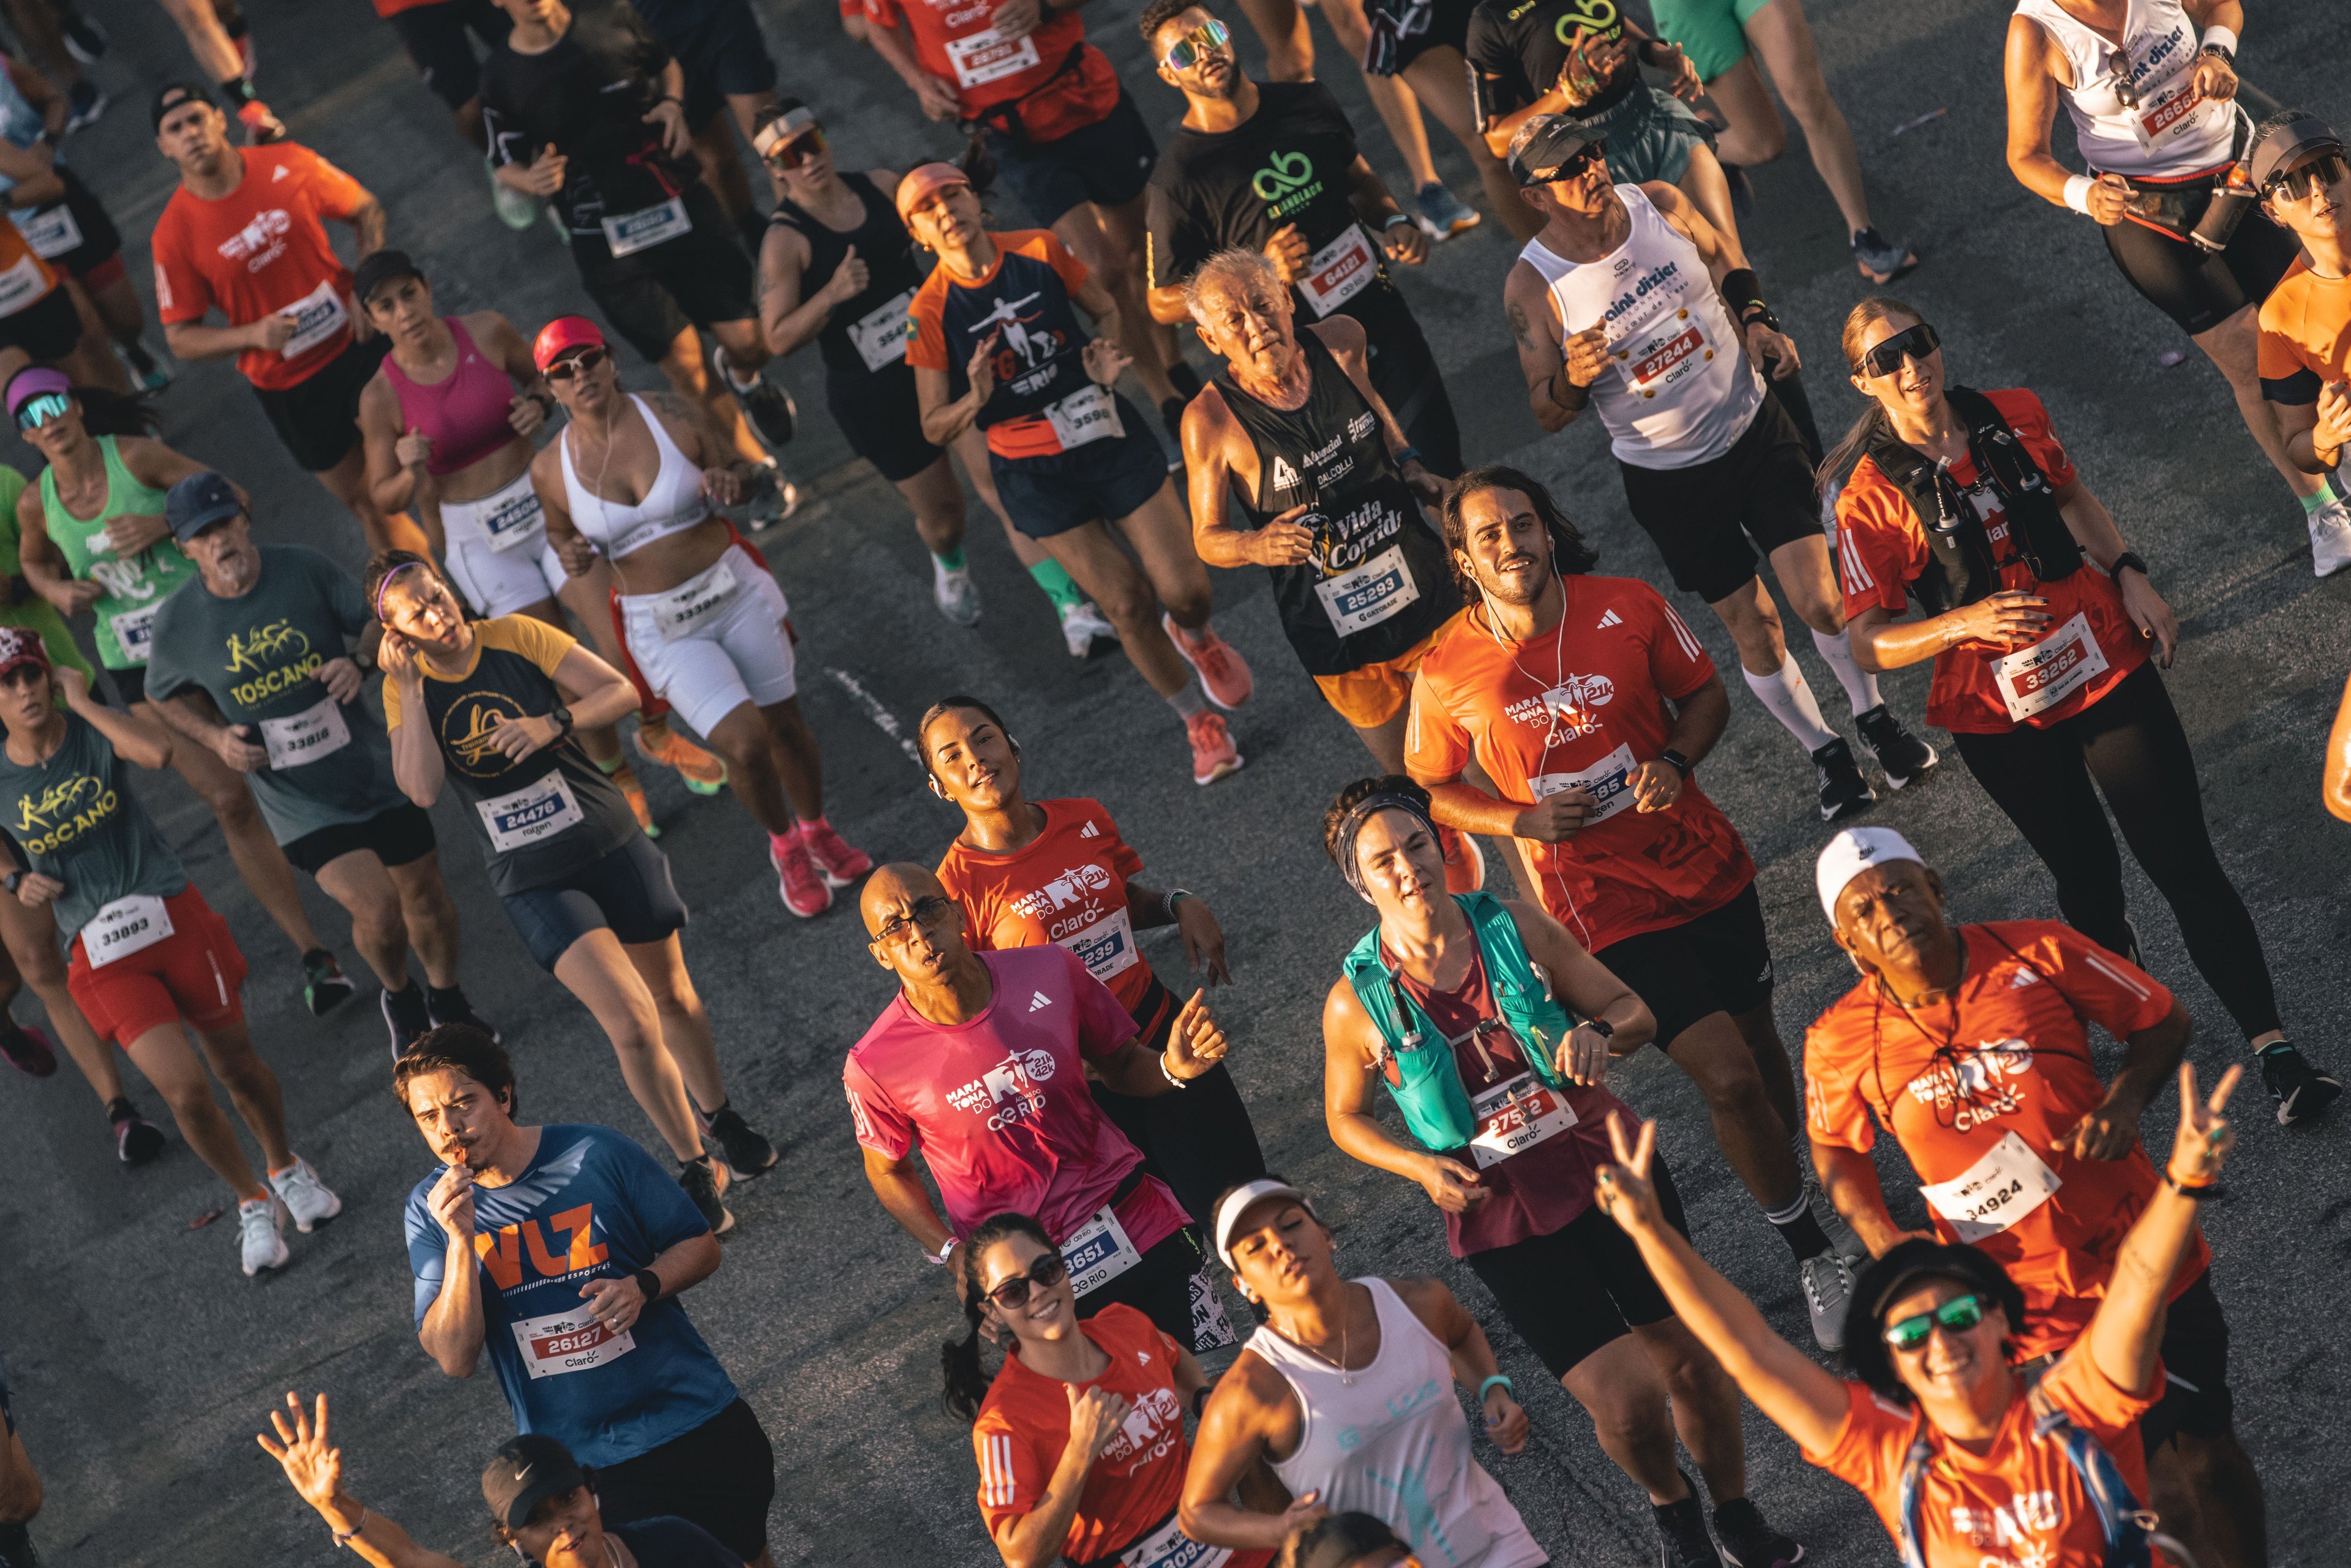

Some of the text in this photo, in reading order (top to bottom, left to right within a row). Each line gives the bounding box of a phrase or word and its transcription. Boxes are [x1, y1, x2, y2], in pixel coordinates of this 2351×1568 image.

[2149, 24, 2184, 66] dizier
[2173, 111, 2199, 135] Claro
[1605, 261, 1679, 322] aint dizier
[1644, 336, 1693, 377] 27244
[1665, 358, 1693, 384] Claro
[1317, 455, 1354, 486] DALCOLLI
[1335, 499, 1383, 541] Vida
[1985, 521, 2009, 544] lar
[1372, 568, 1387, 580] Claro
[1346, 576, 1396, 611] 25293
[1367, 597, 1398, 619] GATORADE
[2055, 638, 2069, 654] Claro
[230, 651, 323, 706] TOSCANO
[2025, 648, 2077, 689] 33262
[1504, 696, 1542, 716] MARA
[1511, 706, 1546, 724] TONA
[1530, 715, 1549, 729] DO
[1544, 713, 1603, 749] Claro
[1594, 770, 1611, 784] Claro
[1010, 890, 1044, 913] MARA
[1018, 898, 1051, 919] TONA
[1036, 905, 1054, 920] DO
[1051, 898, 1104, 939] Claro
[1093, 931, 1108, 943] Claro
[1079, 940, 1114, 964] 239
[1033, 1054, 1052, 1068] 21k
[945, 1079, 983, 1104] MARA
[952, 1089, 988, 1111] TONA
[1515, 1086, 1534, 1101] Claro
[972, 1098, 992, 1114] DO
[1017, 1095, 1046, 1117] RIO
[1488, 1099, 1542, 1135] 2752
[1954, 1083, 2026, 1131] Claro
[1507, 1123, 1541, 1149] Claro
[1966, 1179, 2023, 1221] 34924
[1082, 1229, 1091, 1238] RIO
[568, 1261, 611, 1281] ESPORTES
[1088, 1269, 1107, 1285] RIO
[577, 1316, 596, 1329] Claro
[548, 1325, 601, 1354] 26127
[564, 1350, 599, 1368] Claro
[1115, 1445, 1132, 1462] DO
